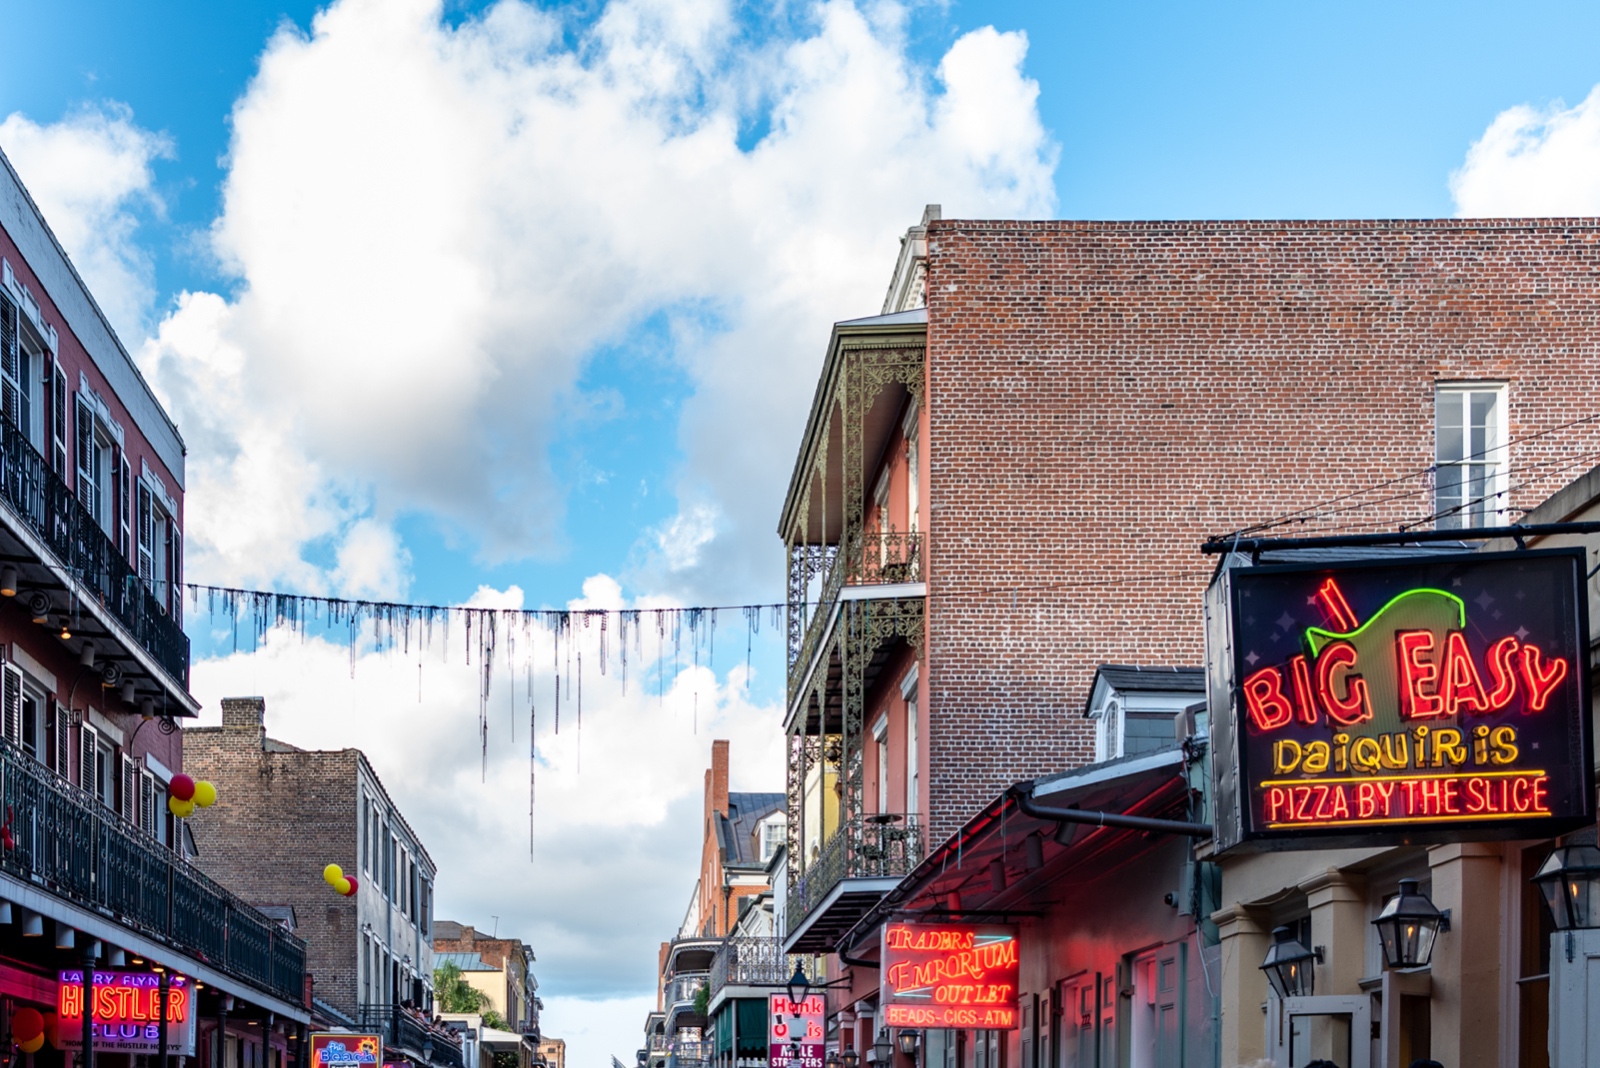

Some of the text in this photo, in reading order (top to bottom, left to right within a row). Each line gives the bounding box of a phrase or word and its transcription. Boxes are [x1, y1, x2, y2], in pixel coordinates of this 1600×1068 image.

[1242, 630, 1568, 731] BIG EASY
[1270, 776, 1549, 822] PIZZA BY THE SLICE
[888, 940, 1018, 993] EMPORIUM
[62, 972, 115, 985] LARY
[61, 985, 185, 1020] HUSTLER
[935, 984, 1011, 1004] OUTLET
[774, 1021, 822, 1037] Ois
[101, 1041, 115, 1049] THE
[117, 1042, 148, 1050] HUSTLER
[150, 1043, 182, 1051] HOEYS"
[781, 1045, 814, 1058] MLE
[320, 1050, 376, 1061] Beach
